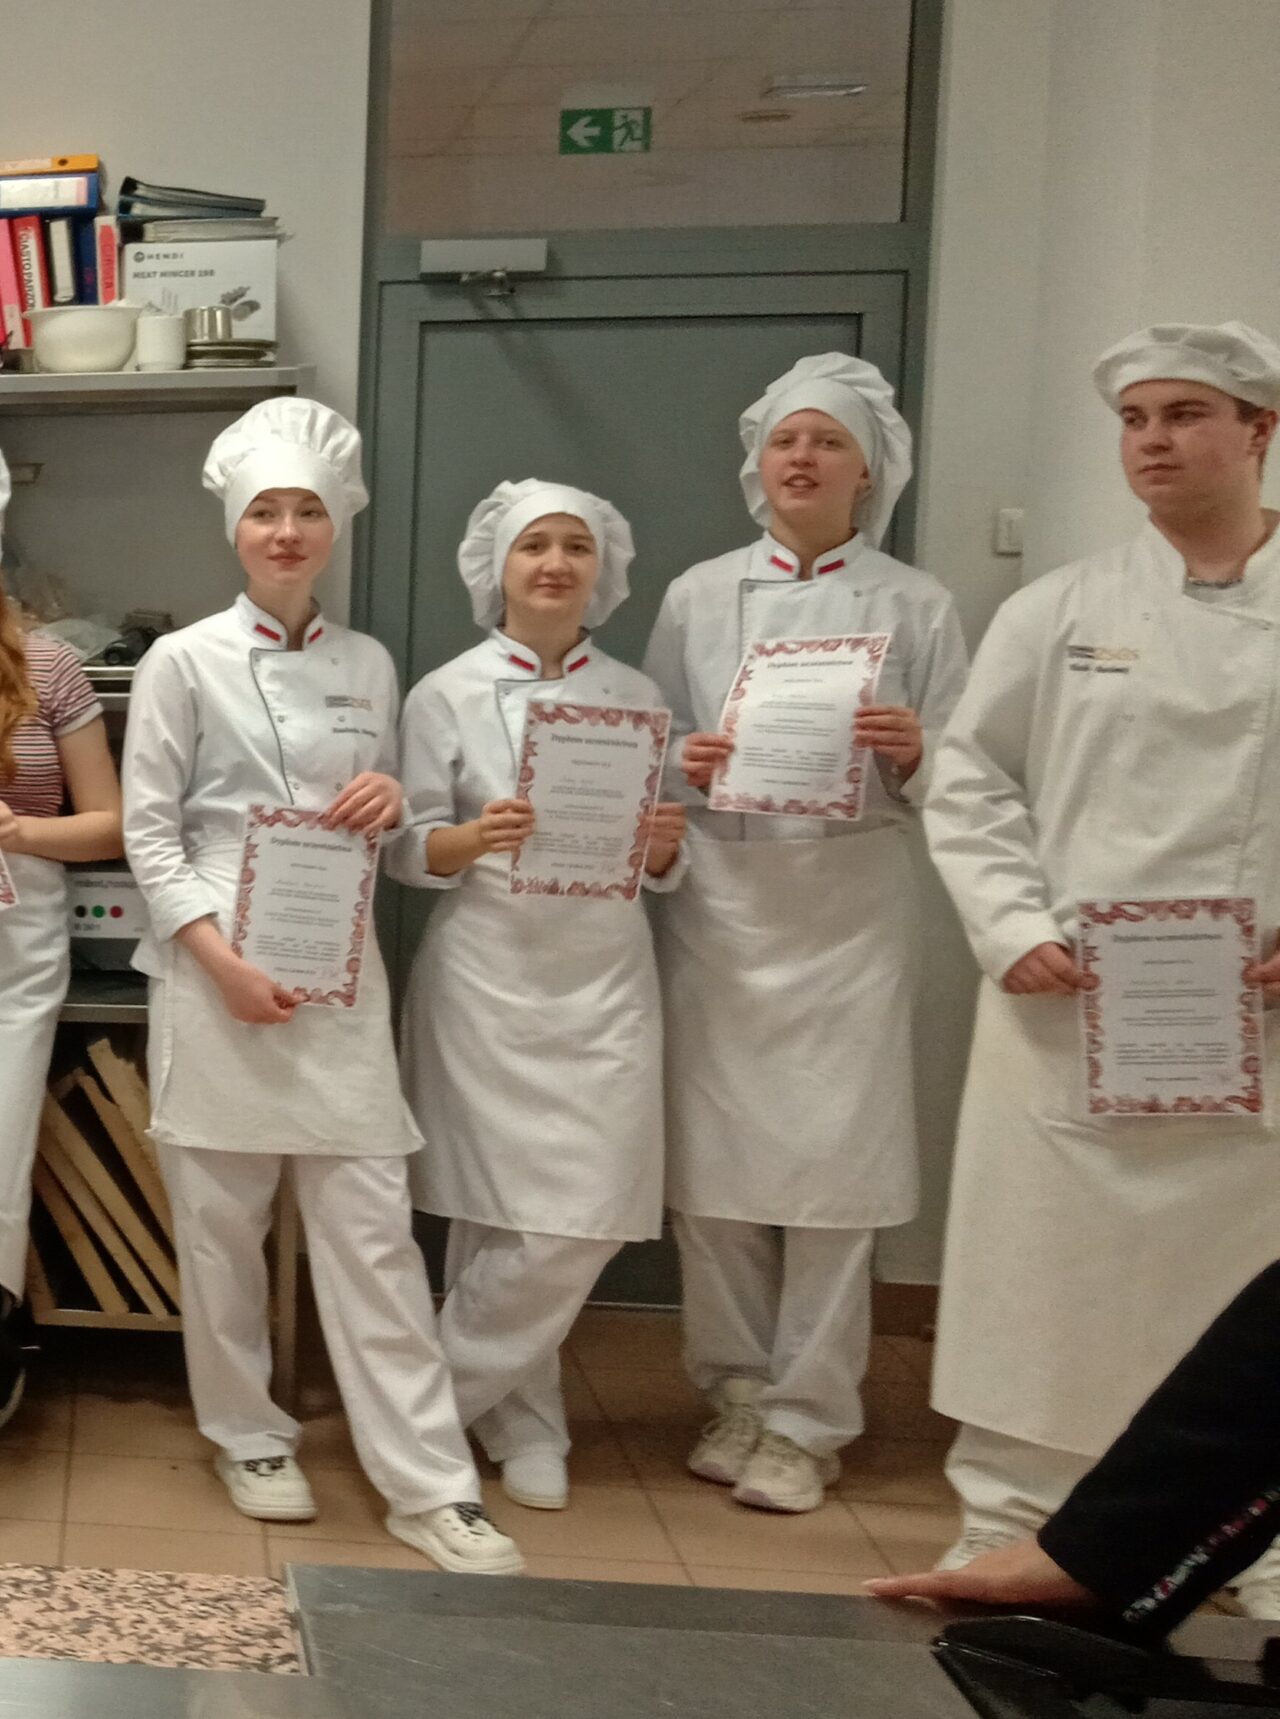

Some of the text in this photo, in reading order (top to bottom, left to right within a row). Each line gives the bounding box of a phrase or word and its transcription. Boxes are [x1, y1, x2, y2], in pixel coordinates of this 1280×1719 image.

[146, 252, 184, 261] HENDI
[132, 271, 157, 279] MEAT
[159, 269, 196, 278] MINCER
